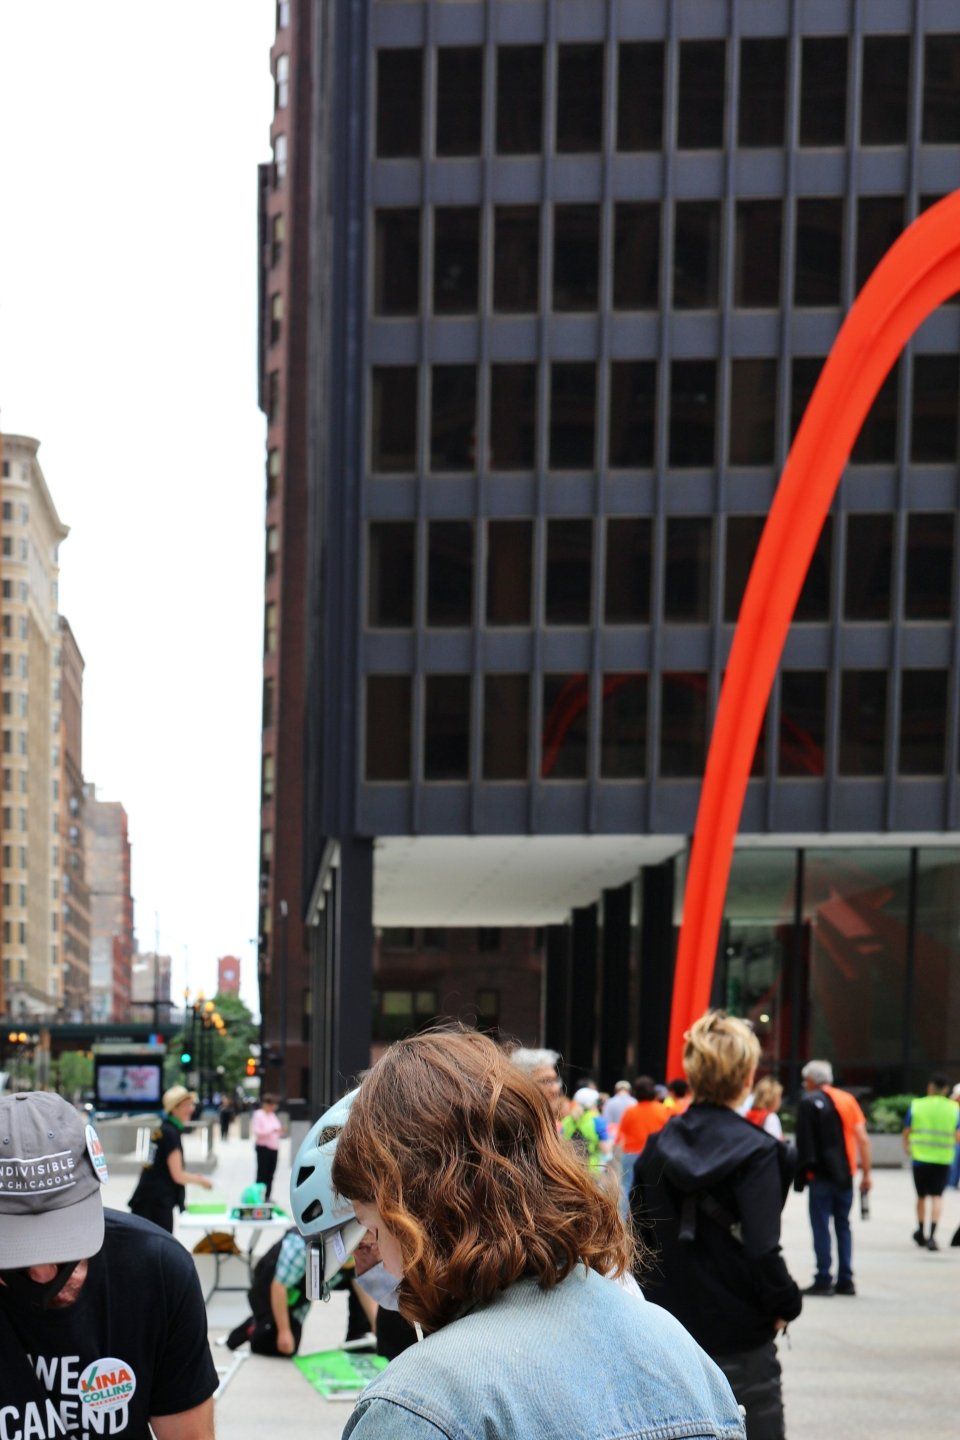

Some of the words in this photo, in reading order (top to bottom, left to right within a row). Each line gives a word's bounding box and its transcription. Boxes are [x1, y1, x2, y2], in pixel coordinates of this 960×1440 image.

[7, 1176, 61, 1190] CHICAGO
[27, 1353, 80, 1396] WE
[81, 1365, 132, 1394] KINA
[82, 1383, 134, 1404] COLLINS
[59, 1400, 130, 1436] END
